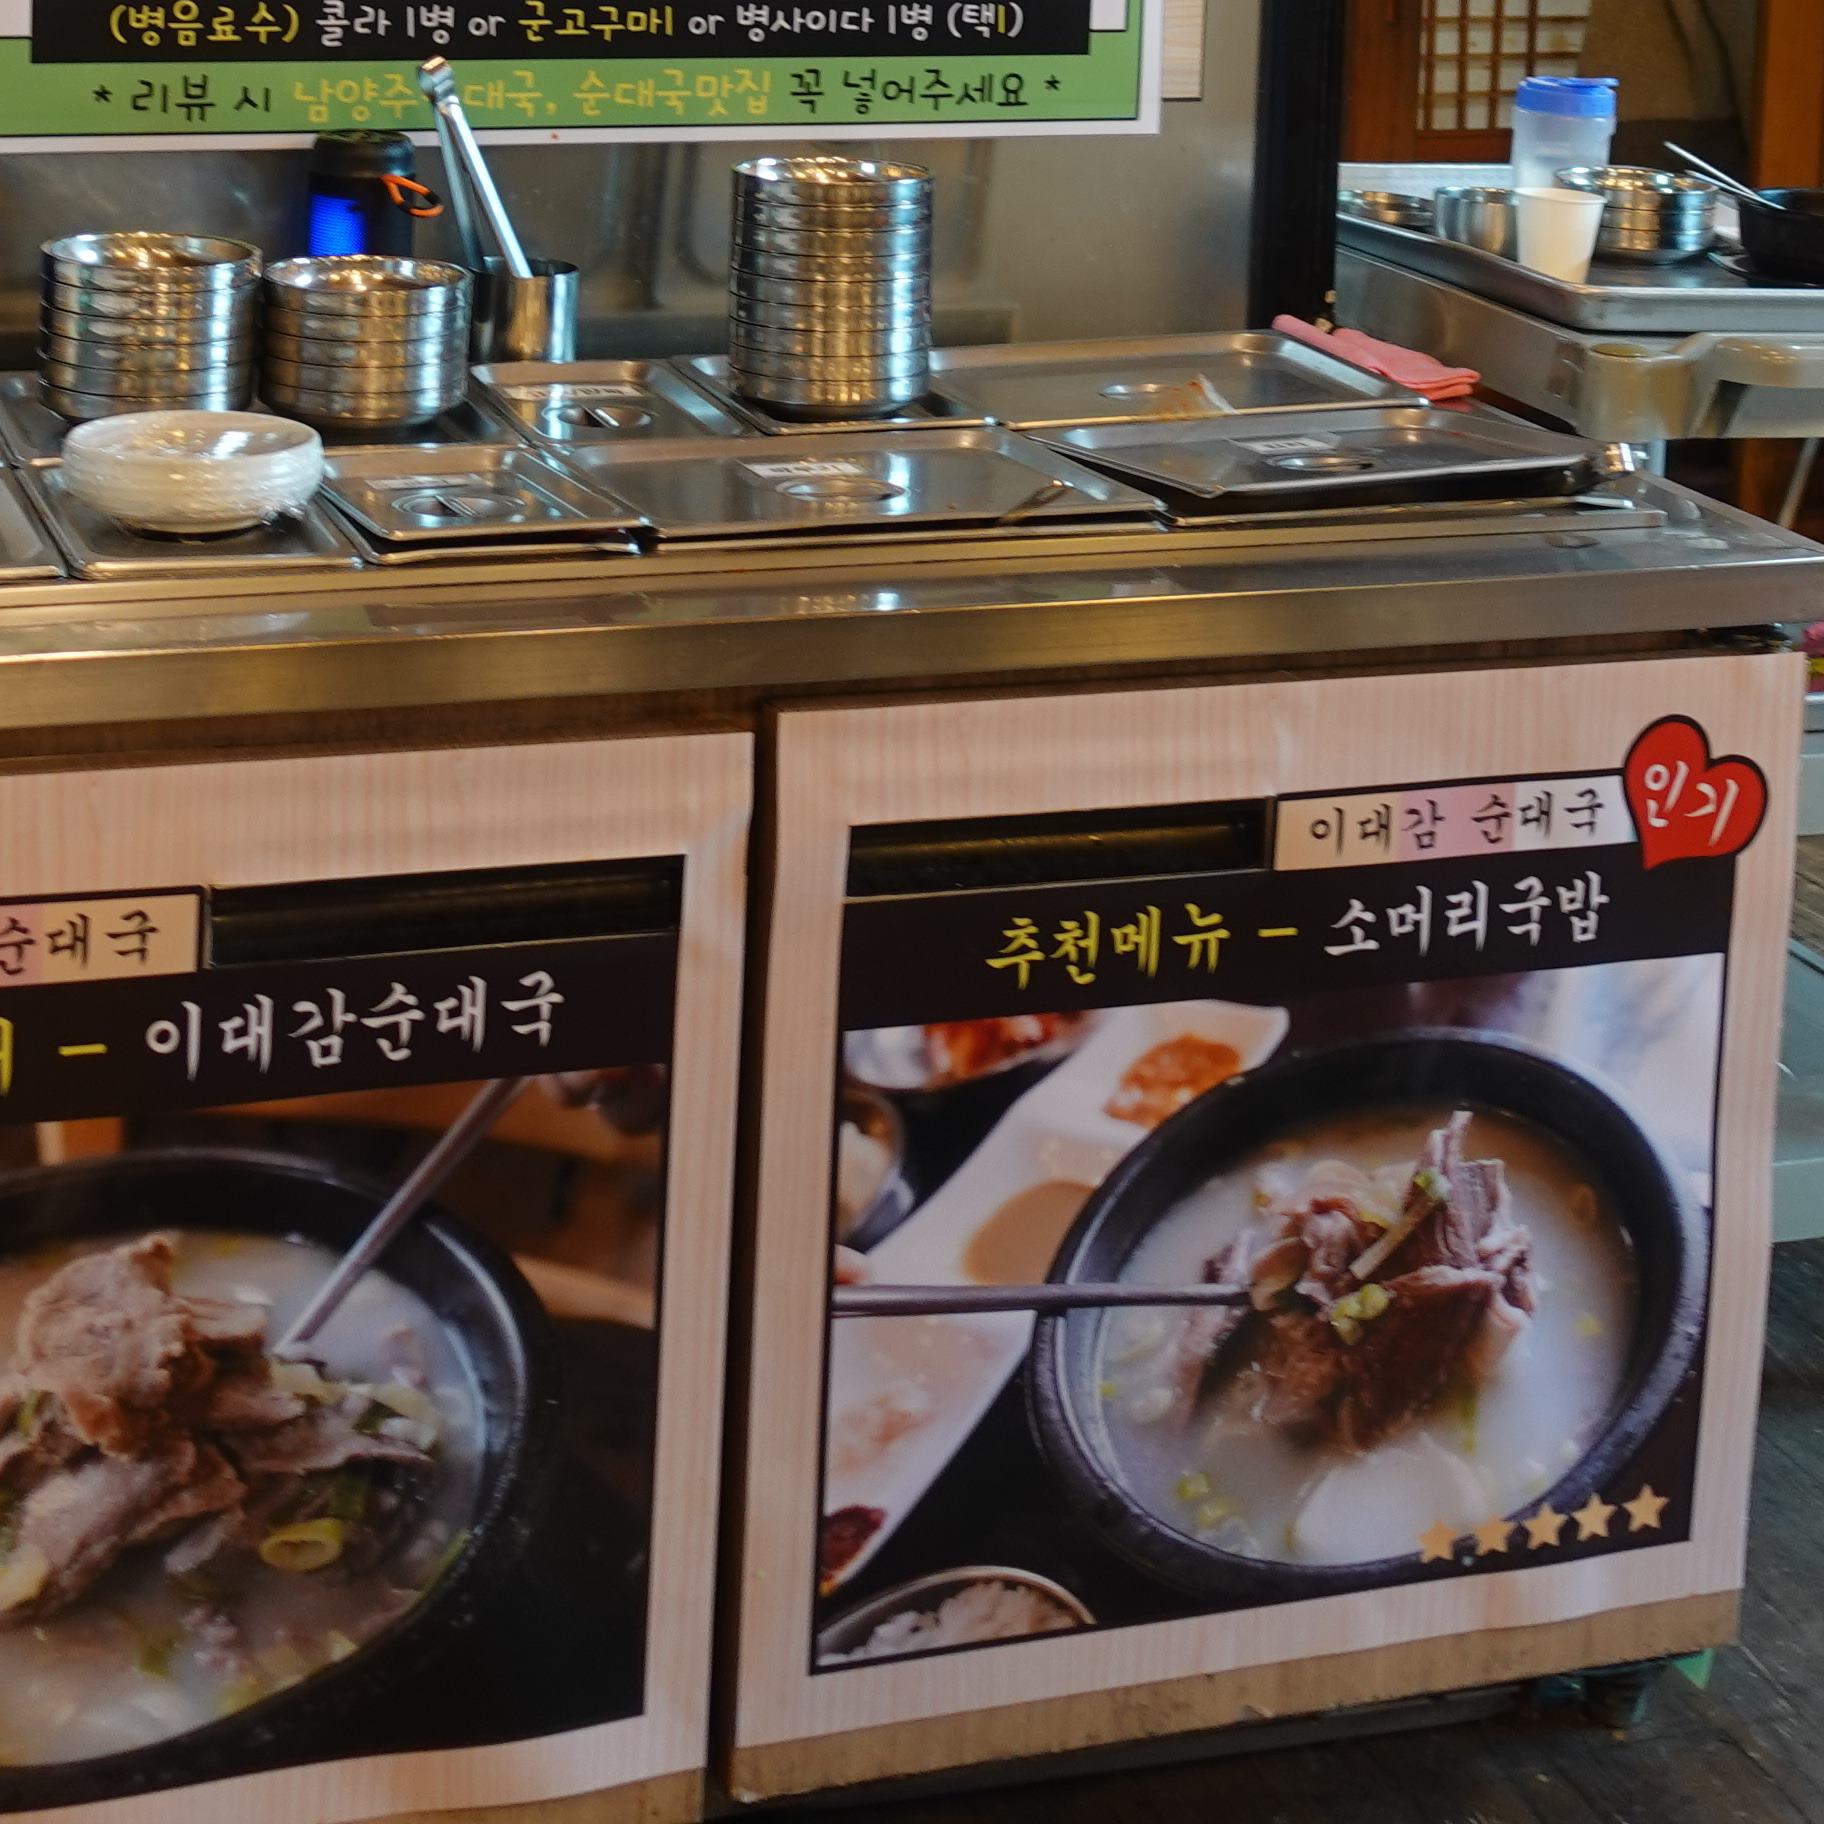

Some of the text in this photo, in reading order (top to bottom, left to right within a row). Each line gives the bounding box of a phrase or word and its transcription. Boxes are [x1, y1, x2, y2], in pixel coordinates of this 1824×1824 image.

[467, 14, 505, 38] or
[688, 12, 725, 37] or
[735, 1, 875, 44] 병사이다
[130, 74, 217, 124] 리뷰
[233, 82, 273, 113] 시
[572, 67, 773, 118] 순대국맛집
[789, 67, 826, 115] 꼭
[841, 67, 1029, 116] 넣어주세요
[1309, 785, 1607, 862] 이대감 순대국
[1643, 756, 1741, 847] 인기
[984, 899, 1234, 988] 추천메뉴
[1323, 870, 1612, 960] 소머리국밥
[146, 966, 566, 1082] 이대감순대국
